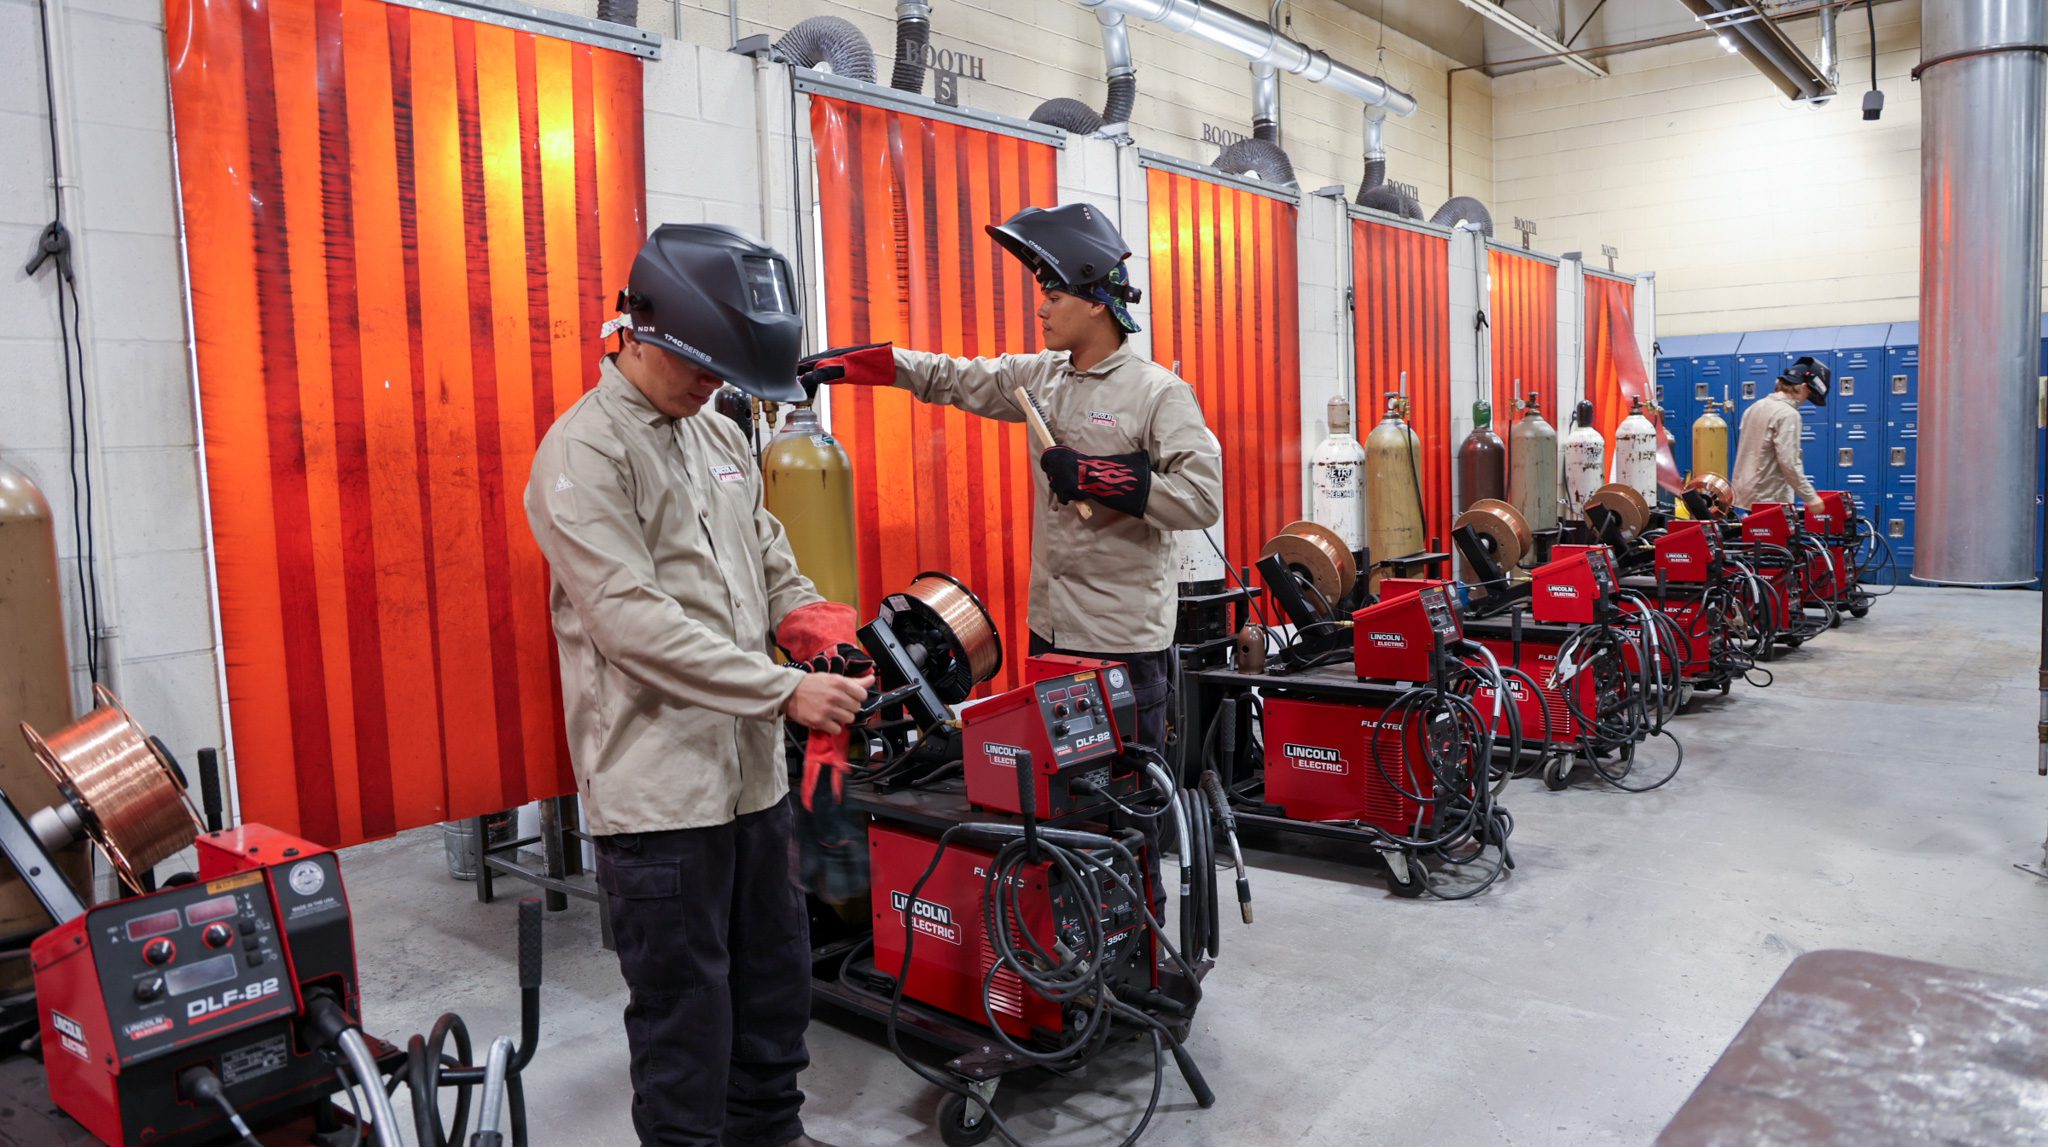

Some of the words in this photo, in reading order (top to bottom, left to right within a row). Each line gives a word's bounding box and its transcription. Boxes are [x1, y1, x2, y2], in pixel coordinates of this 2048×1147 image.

[901, 38, 986, 81] BOOTH
[941, 76, 951, 100] 5
[1200, 122, 1249, 147] BOOT
[1387, 178, 1419, 202] BOOTH
[664, 333, 684, 348] 1740
[682, 343, 712, 363] SERIES
[1547, 585, 1573, 593] LINCOLN
[1370, 633, 1401, 641] LINCOLN
[1075, 731, 1111, 748] DLF-82
[1286, 745, 1337, 762] LINCOLN
[1298, 759, 1343, 773] ELECTRIC
[187, 977, 280, 1018] DLF-82
[52, 1012, 83, 1042] LINCOLN
[124, 1017, 164, 1037] LINCOLN
